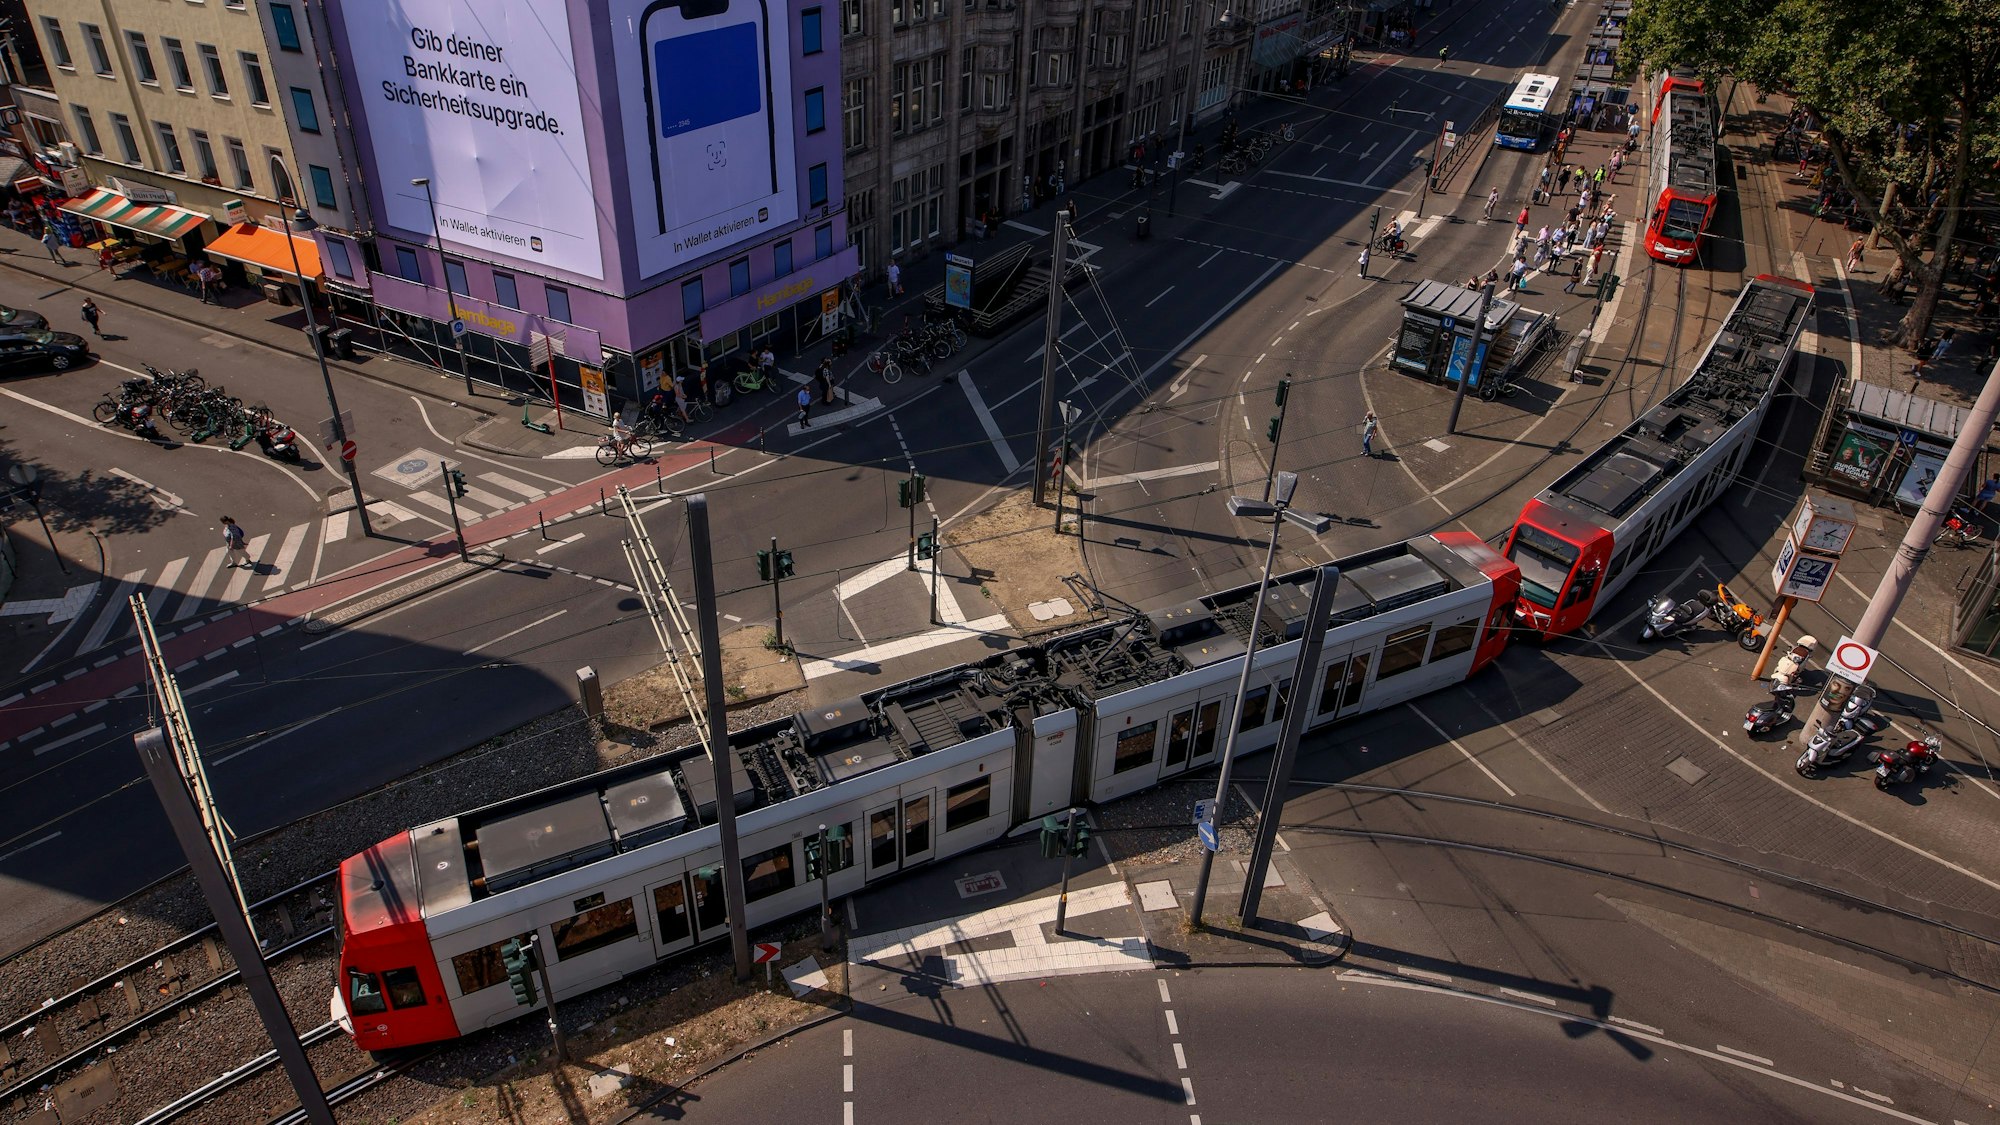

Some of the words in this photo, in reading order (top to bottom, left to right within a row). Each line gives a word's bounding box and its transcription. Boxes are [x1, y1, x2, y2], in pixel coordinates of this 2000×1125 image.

[411, 27, 442, 53] Gib
[446, 33, 503, 62] deiner
[403, 55, 496, 92] Bankkarte
[500, 74, 528, 98] ein
[381, 80, 565, 136] Sicherheitsupgrade.
[678, 119, 691, 128] 2345
[439, 216, 449, 227] In
[450, 218, 479, 236] Wallet
[480, 227, 526, 247] aktivieren
[673, 242, 683, 253] In
[684, 230, 712, 249] Wallet
[714, 215, 755, 239] aktivieren
[757, 276, 814, 312] Hambaga
[1444, 318, 1453, 328] U
[1858, 424, 1888, 438] Neumarkt
[1903, 432, 1914, 443] U
[1834, 465, 1845, 473] DIE
[1845, 468, 1871, 480] SCHULE
[1835, 461, 1862, 474] ZURÜCK
[1798, 558, 1826, 575] 97
